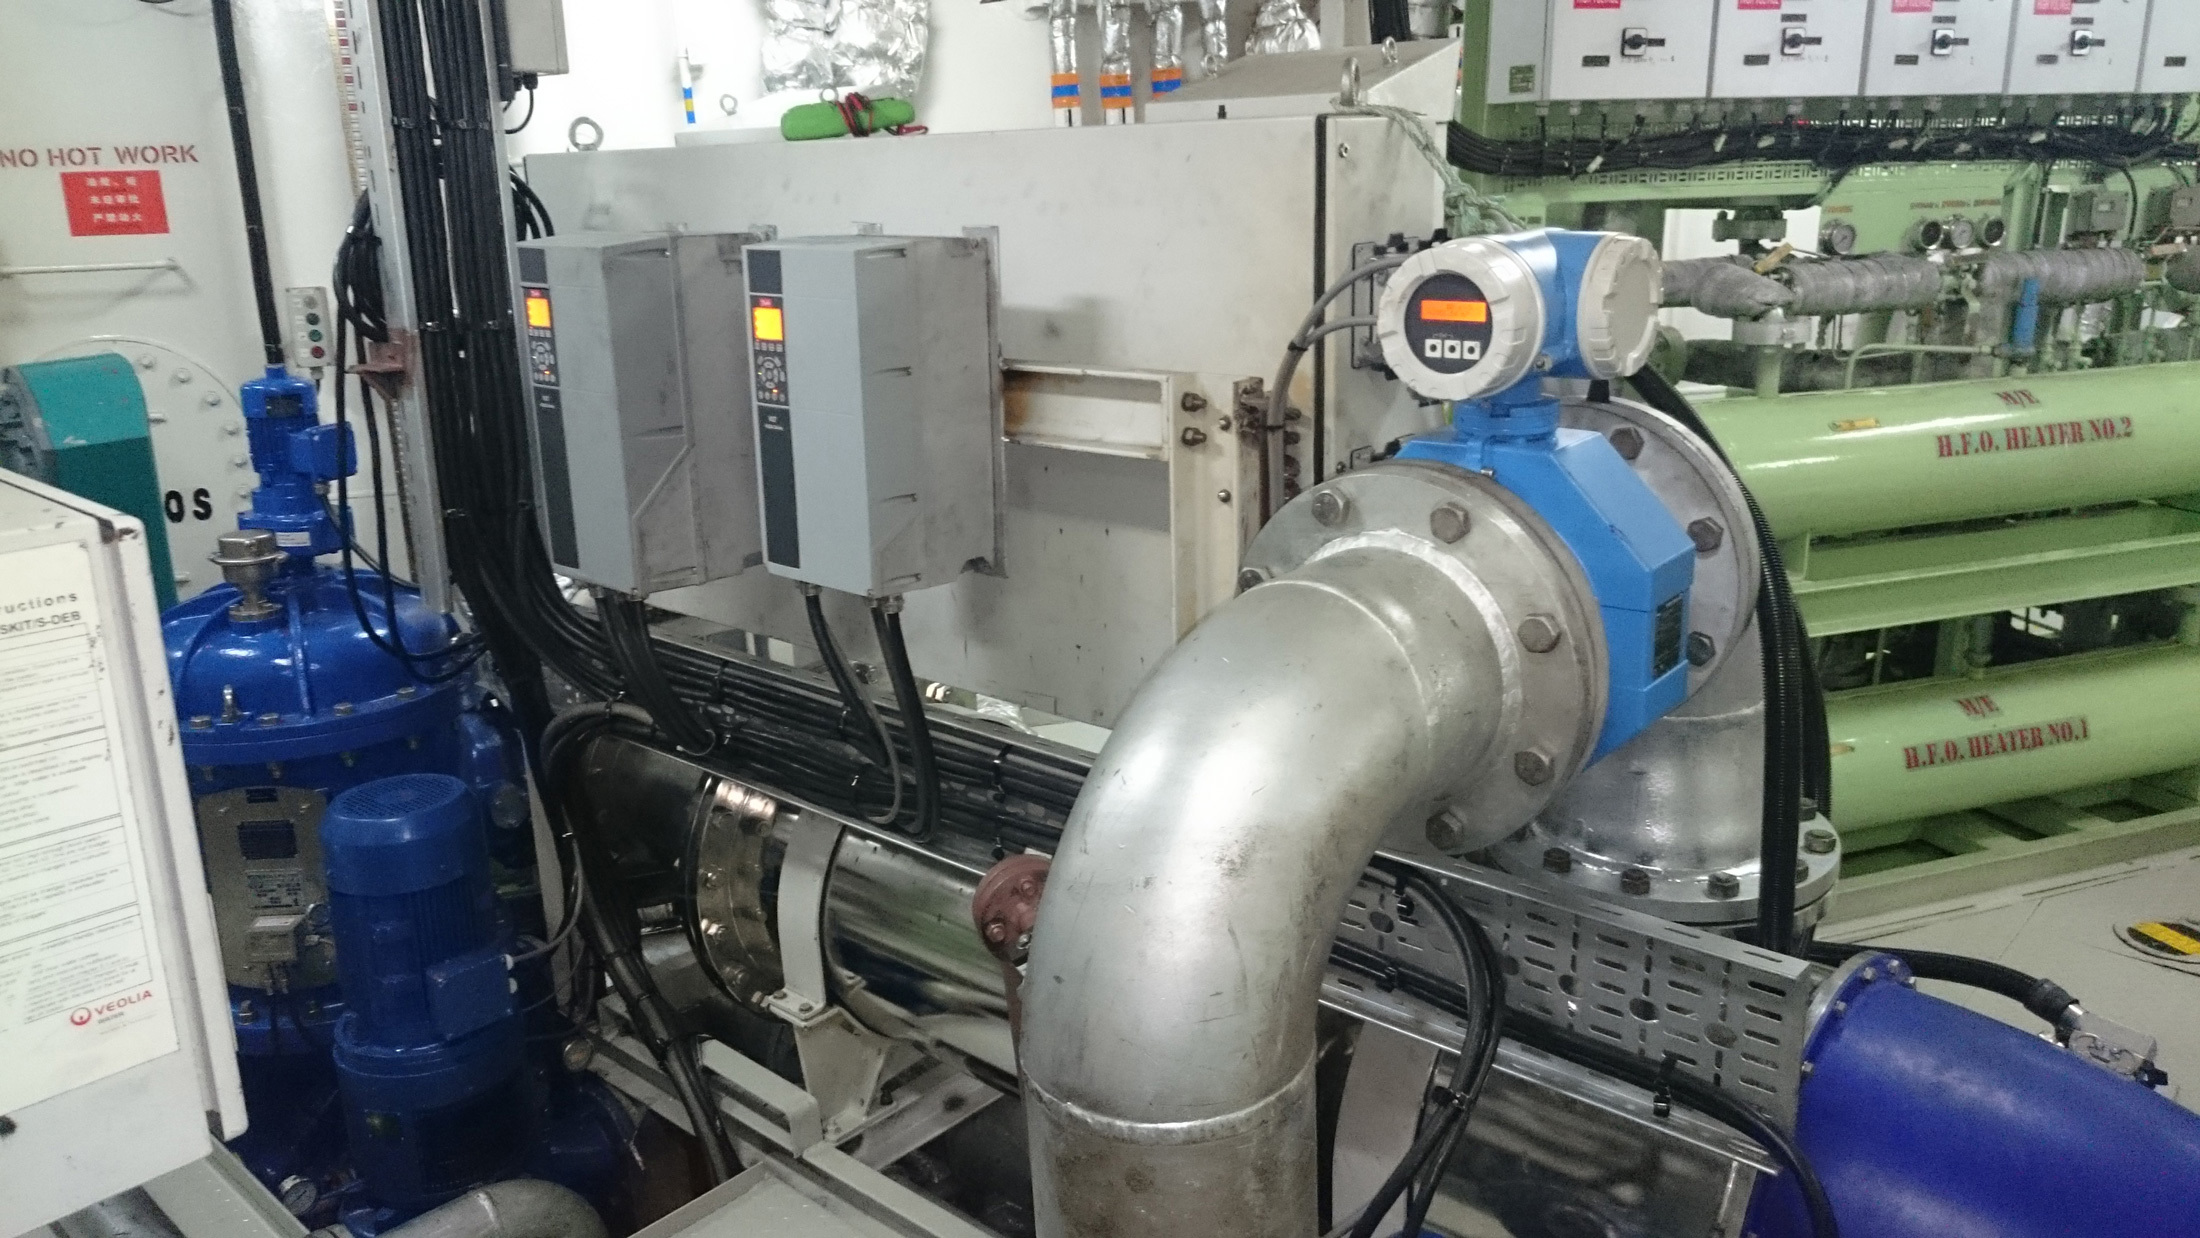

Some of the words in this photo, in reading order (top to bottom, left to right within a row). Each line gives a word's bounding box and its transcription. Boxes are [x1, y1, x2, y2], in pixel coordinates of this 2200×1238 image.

[0, 148, 39, 168] NO
[47, 147, 102, 167] HOT
[114, 144, 200, 165] WORK
[1937, 430, 2000, 458] H.F.O.
[2003, 420, 2086, 451] HEATER
[2088, 415, 2133, 442] NO.2
[1904, 740, 1965, 769] H.F.O.
[1967, 727, 2044, 758] HEATER
[2047, 717, 2089, 746] NO.1
[94, 990, 153, 1015] VEOLIA
